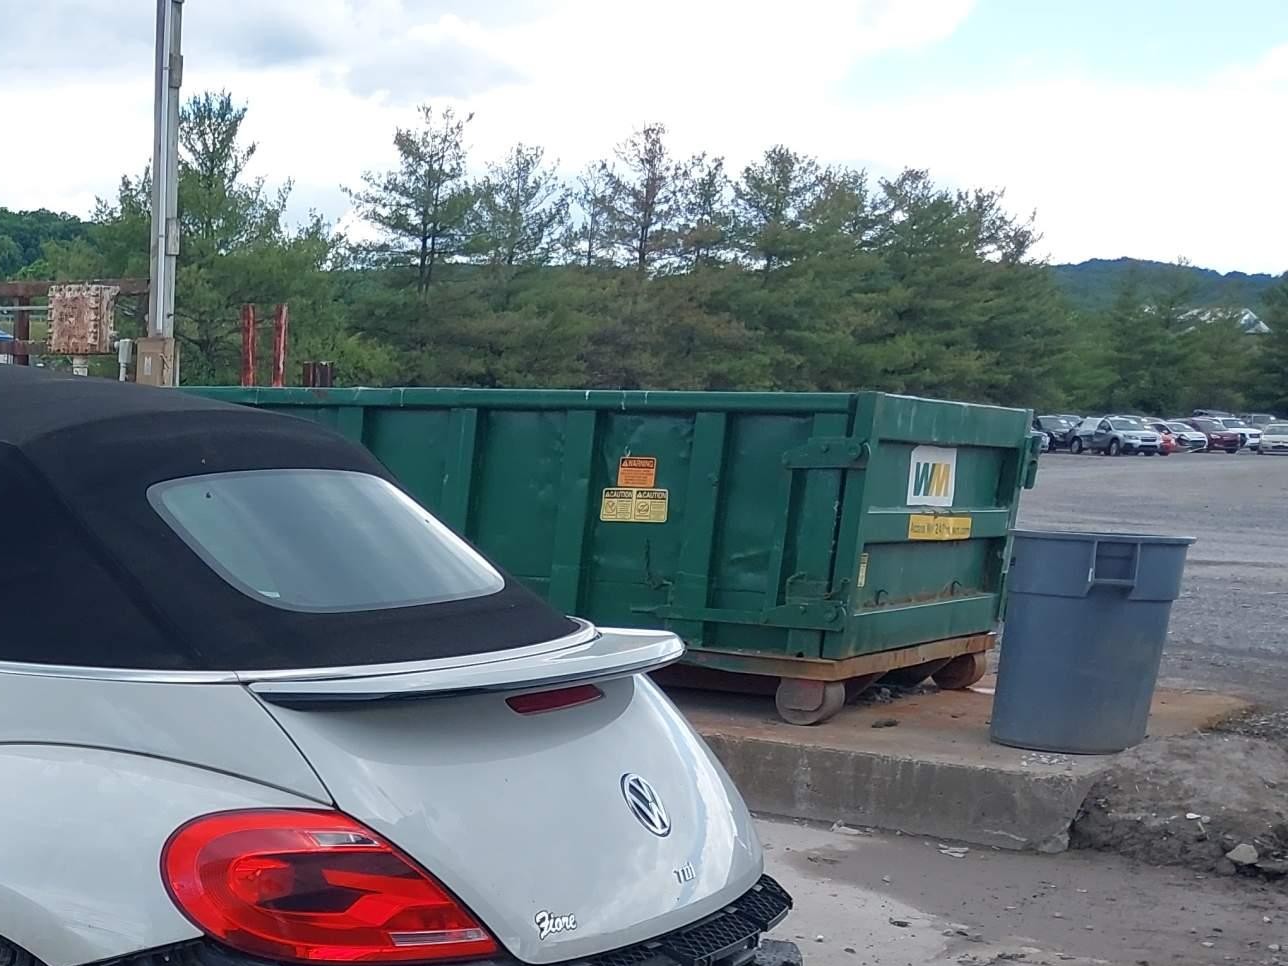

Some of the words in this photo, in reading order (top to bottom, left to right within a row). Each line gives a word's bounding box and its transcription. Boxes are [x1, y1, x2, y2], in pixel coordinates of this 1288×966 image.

[912, 462, 952, 497] WM
[672, 862, 696, 884] TDI
[535, 910, 577, 940] Fiore
